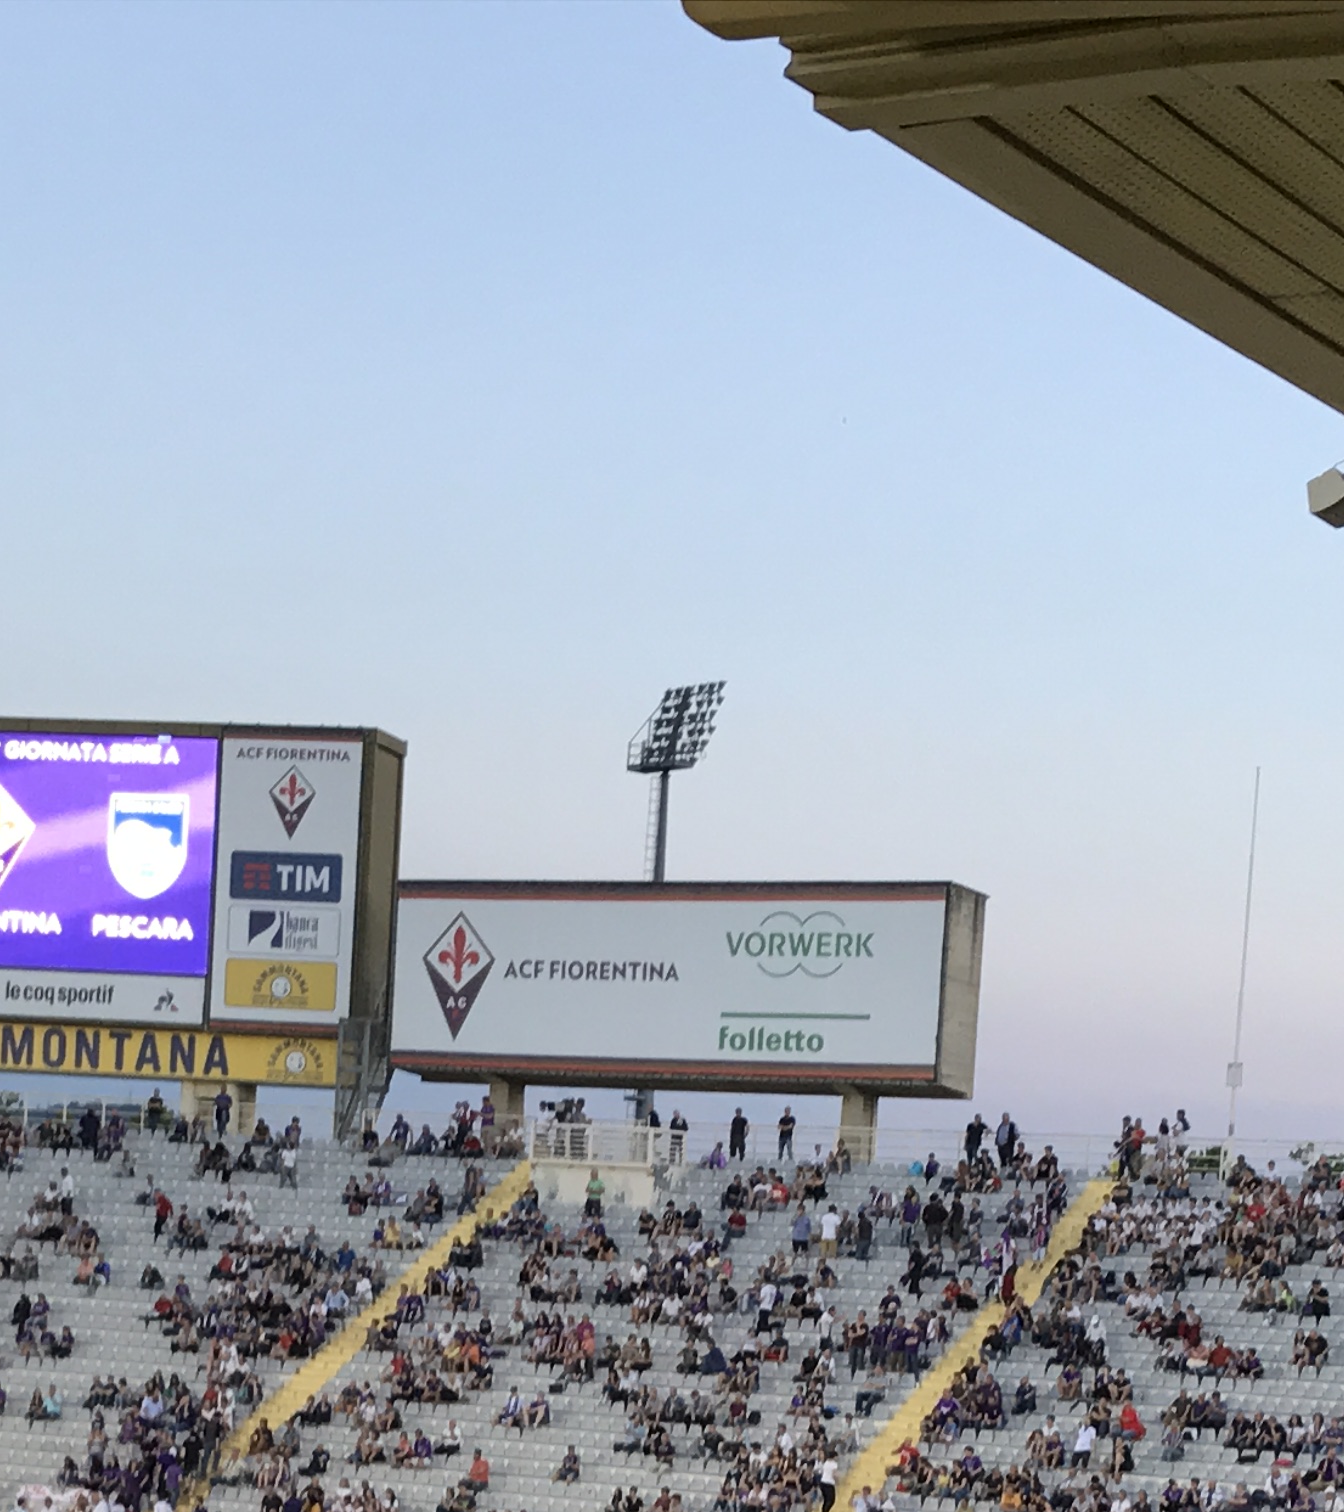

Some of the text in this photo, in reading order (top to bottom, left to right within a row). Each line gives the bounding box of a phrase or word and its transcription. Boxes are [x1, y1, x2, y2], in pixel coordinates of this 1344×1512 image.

[4, 740, 107, 763] GIORNATA
[163, 745, 181, 765] A
[236, 746, 351, 763] ACF FIORENTINA
[276, 864, 330, 894] TIM
[92, 913, 194, 942] PESCARA
[726, 931, 875, 958] VORWERK
[504, 959, 680, 982] ACF FIORENTINA
[5, 979, 116, 1007] le coq sportif
[718, 1025, 825, 1053] folletto
